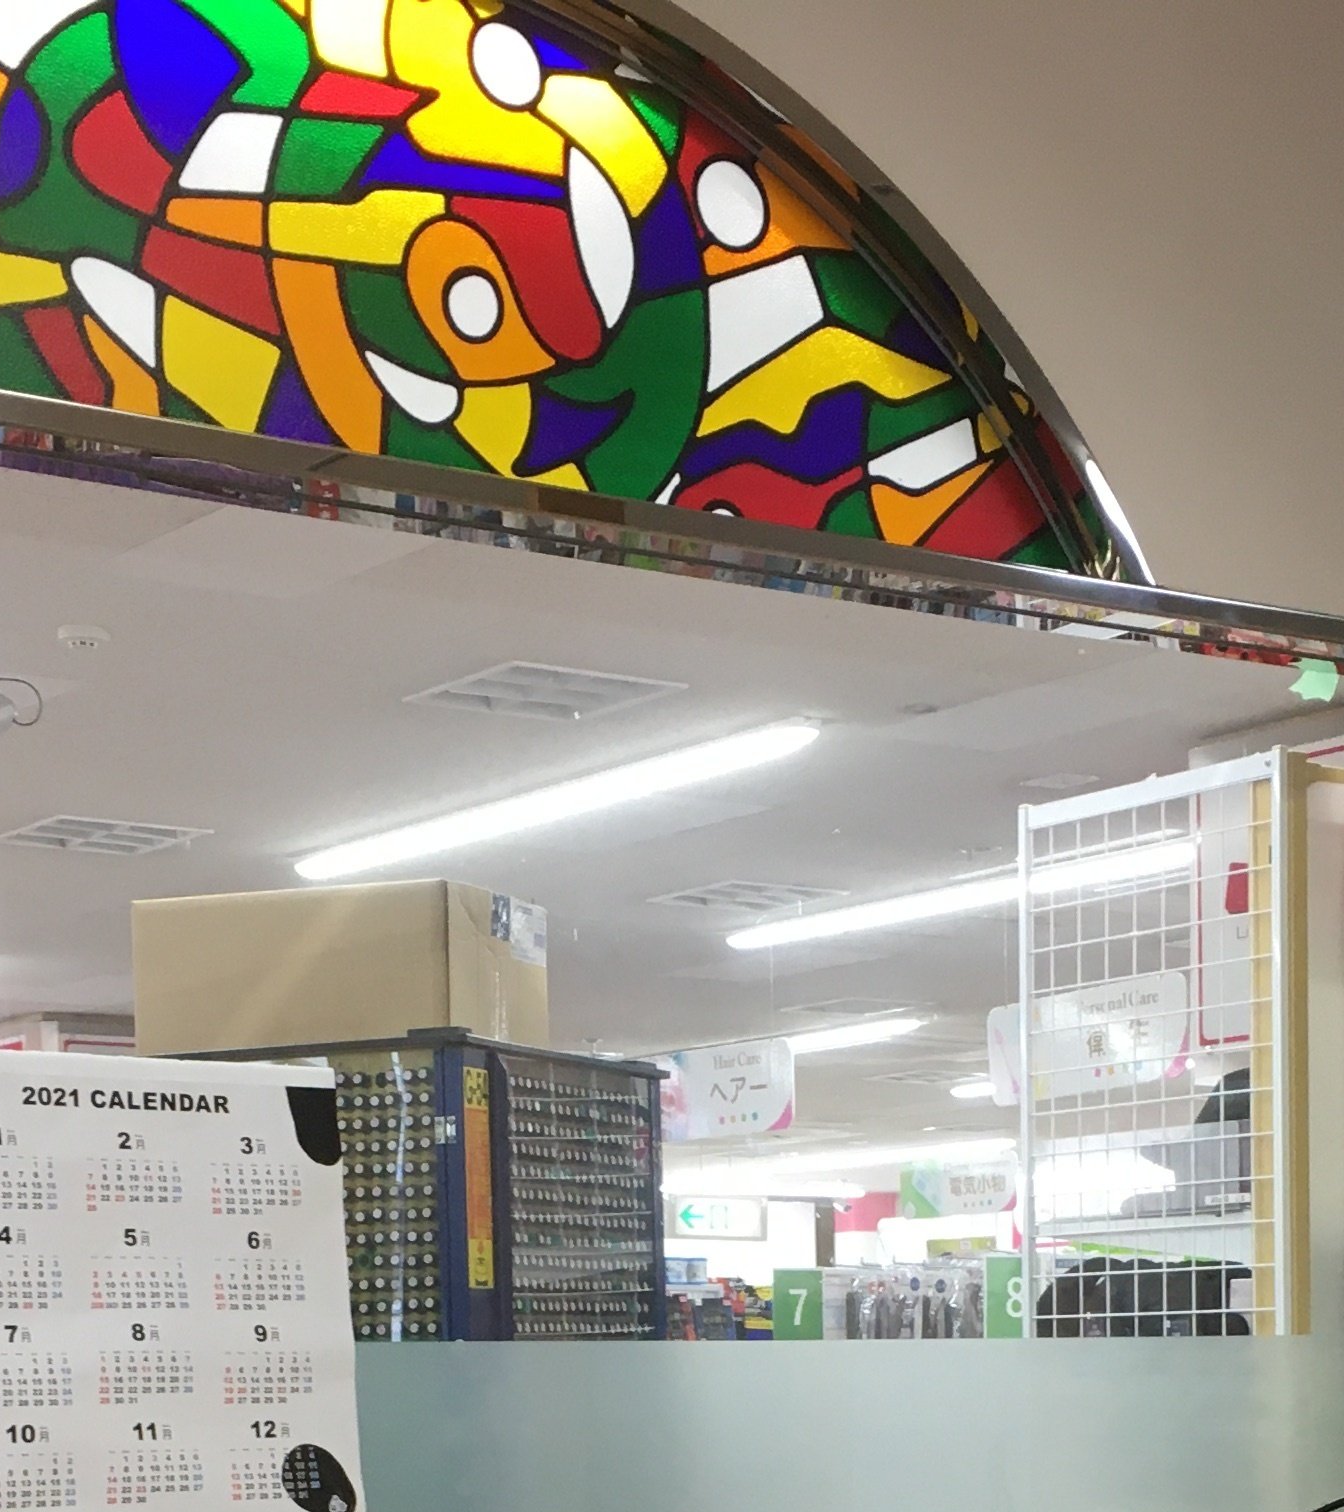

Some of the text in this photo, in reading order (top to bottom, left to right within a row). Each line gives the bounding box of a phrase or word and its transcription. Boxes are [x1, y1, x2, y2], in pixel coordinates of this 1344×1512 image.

[21, 1086, 230, 1115] 2021 CALENDAR
[710, 1076, 768, 1104] ヘアー
[788, 1288, 807, 1326] 7
[1006, 1276, 1023, 1317] 8
